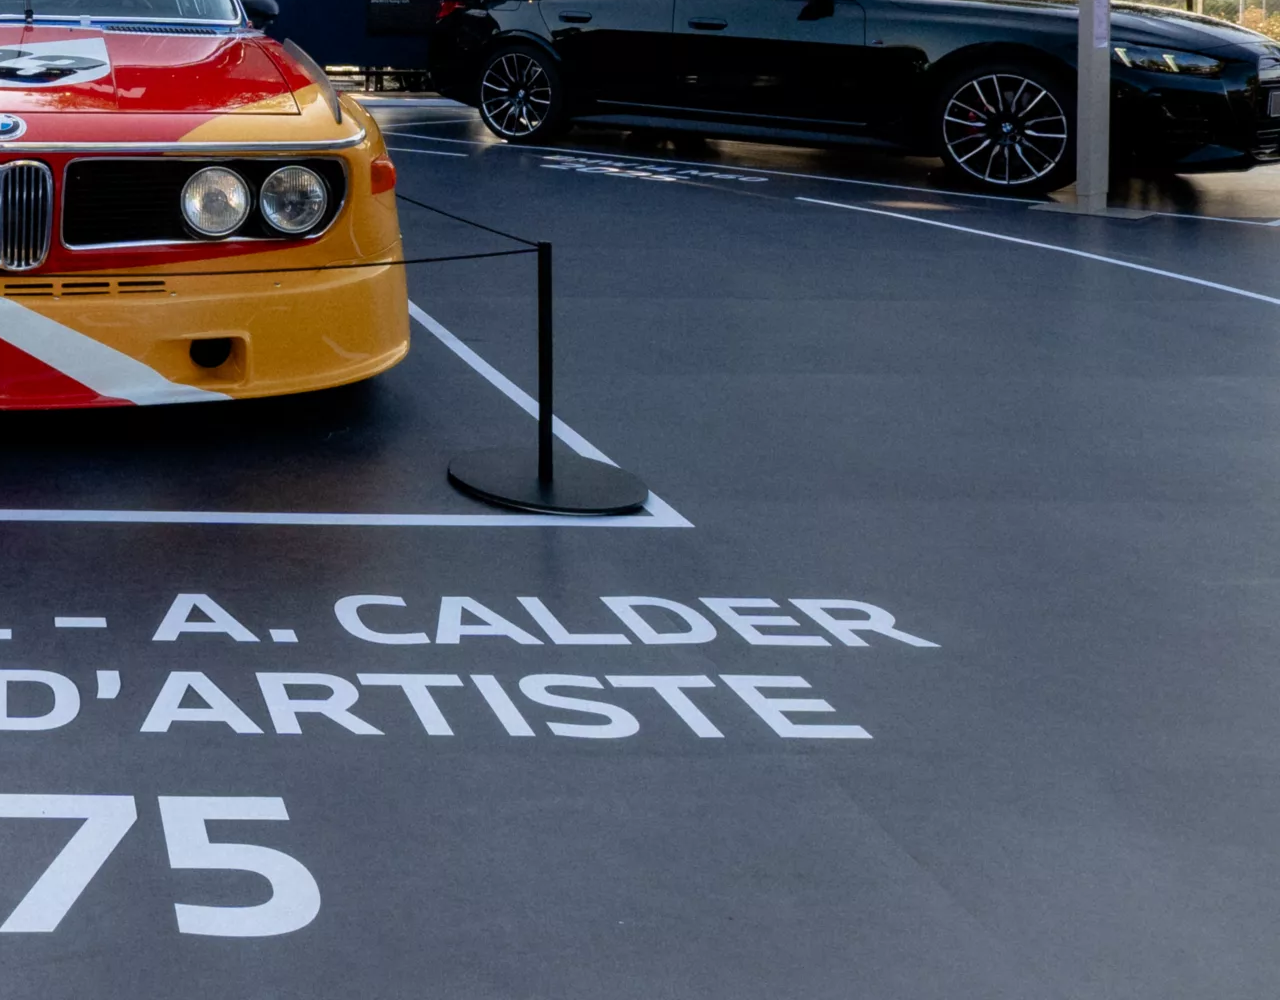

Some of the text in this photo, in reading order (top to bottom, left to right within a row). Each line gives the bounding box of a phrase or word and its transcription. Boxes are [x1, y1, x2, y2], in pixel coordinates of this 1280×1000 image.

[542, 155, 640, 167] BMW
[539, 162, 691, 182] 2025
[151, 593, 298, 642] A.
[333, 595, 941, 648] CALDER
